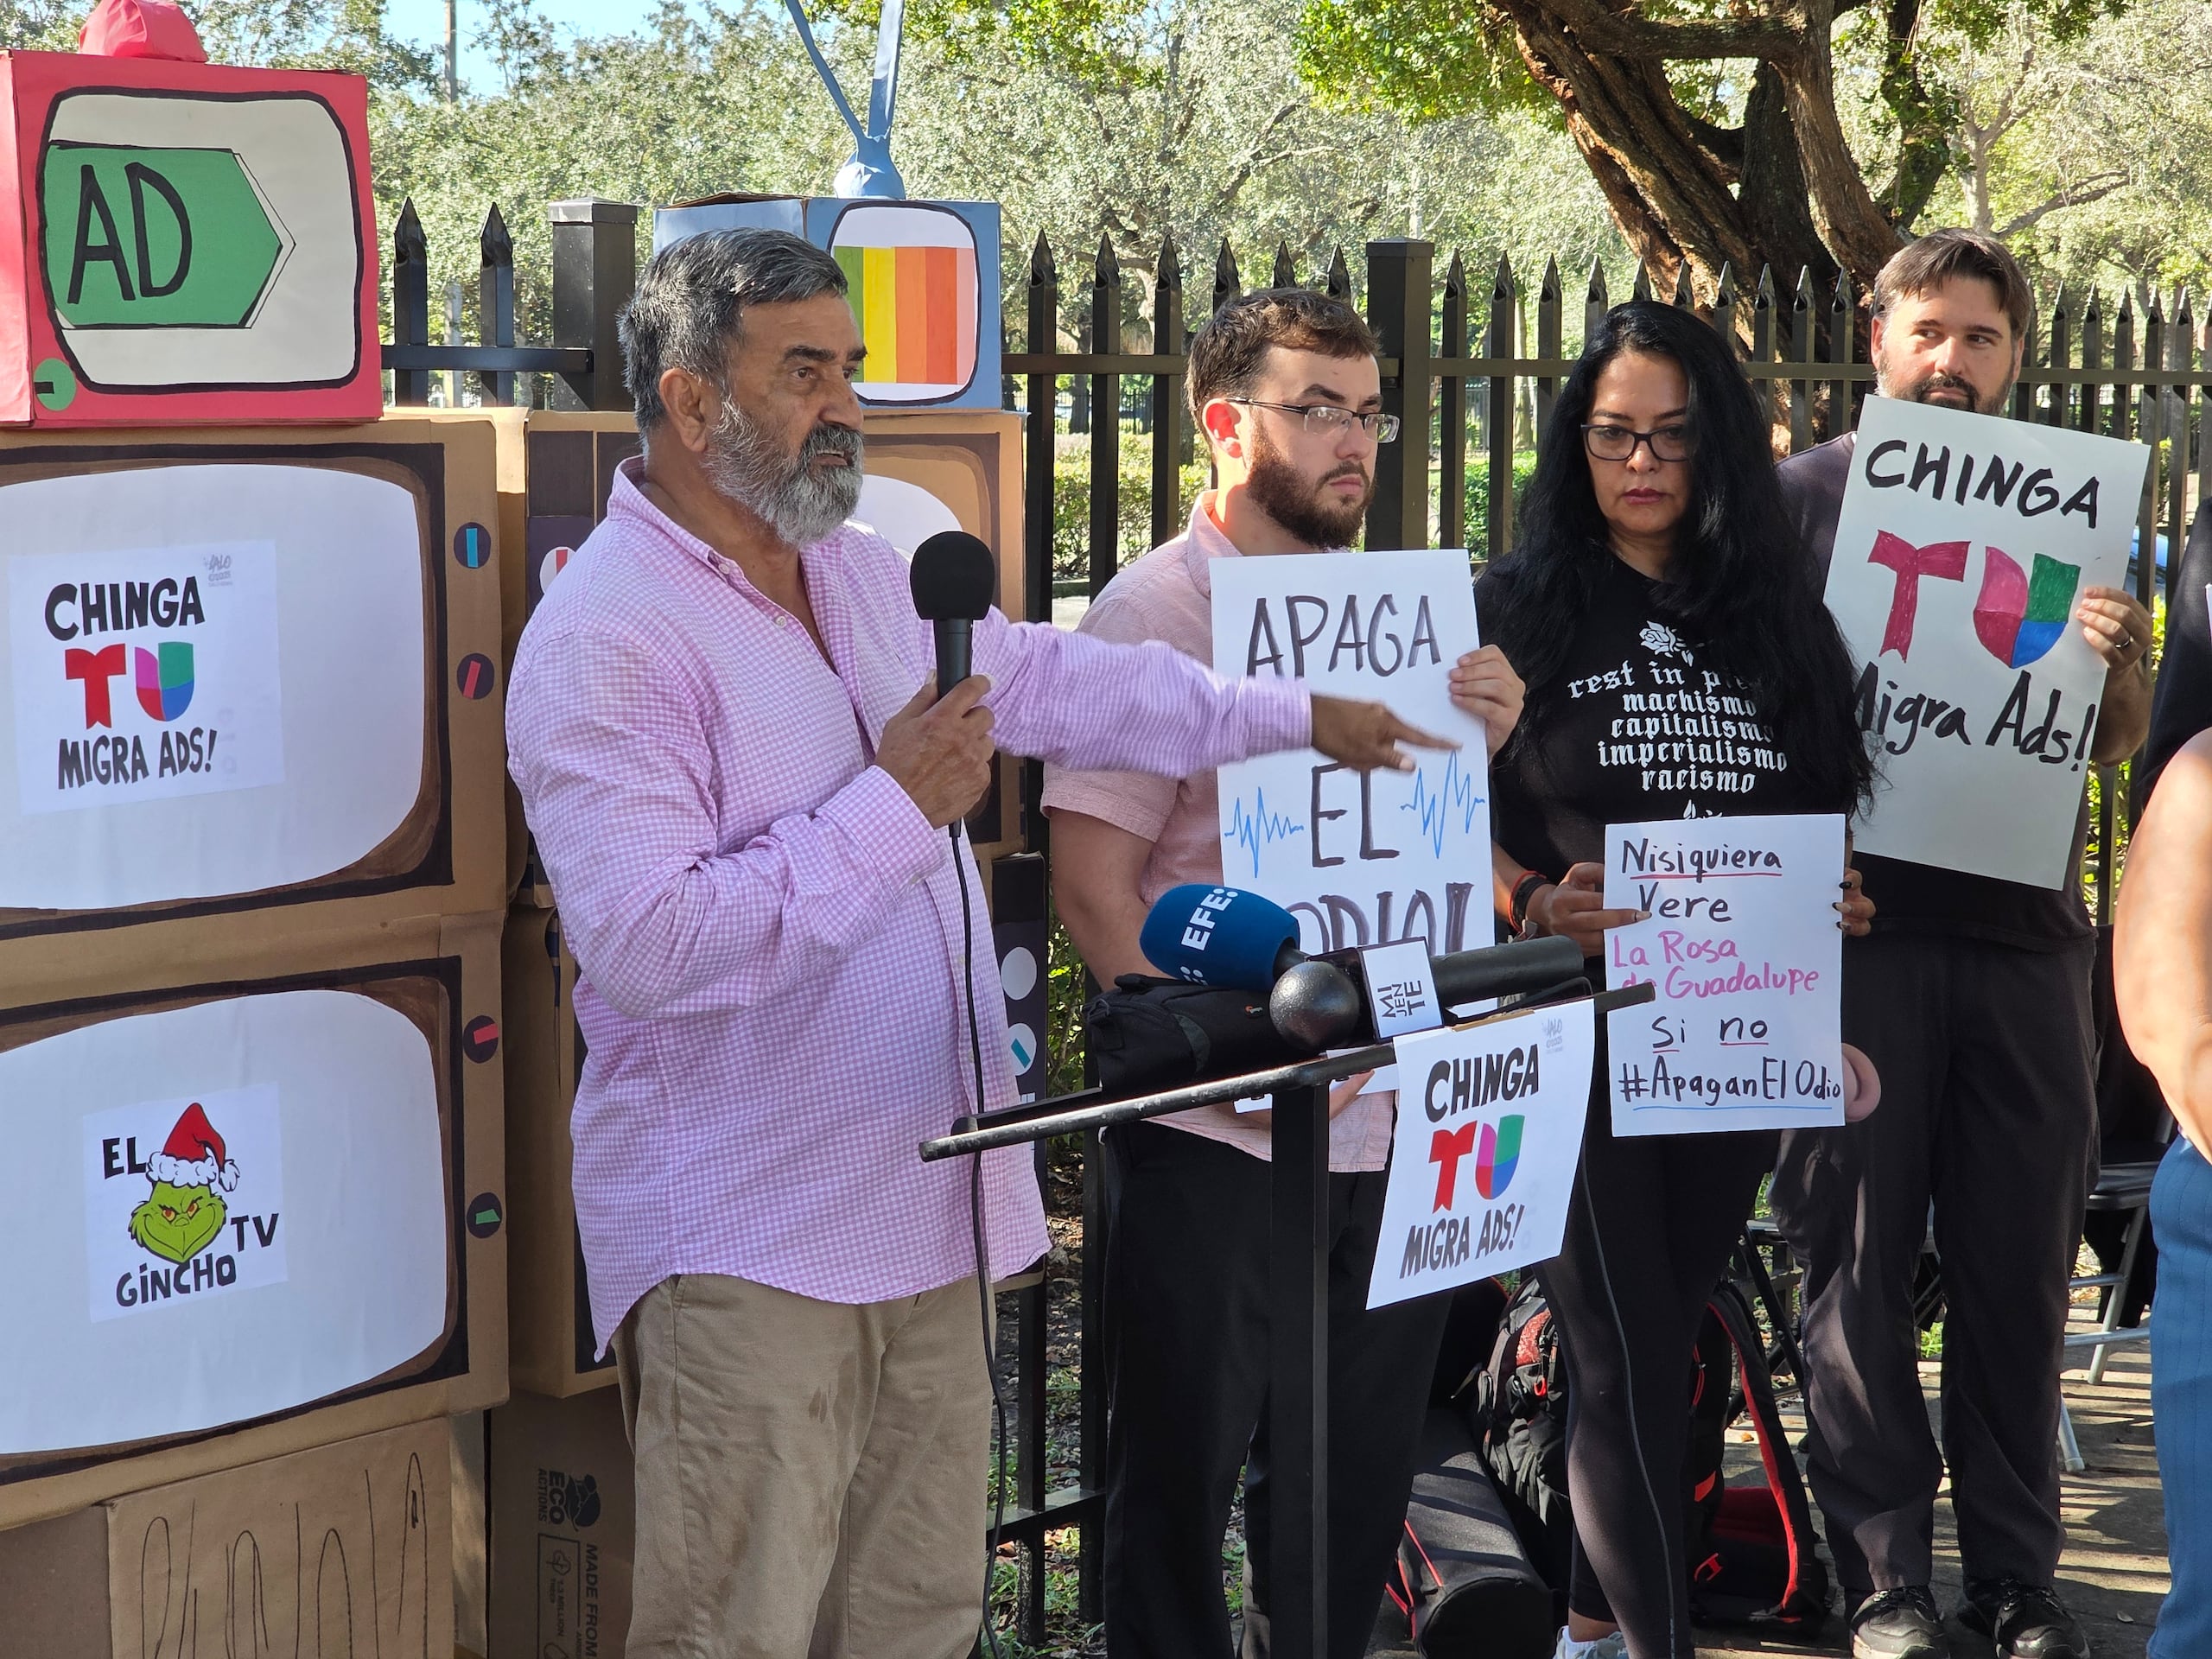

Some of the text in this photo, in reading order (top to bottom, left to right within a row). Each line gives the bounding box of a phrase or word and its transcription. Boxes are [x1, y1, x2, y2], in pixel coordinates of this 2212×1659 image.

[67, 162, 192, 305] AD
[1865, 439, 2100, 530] CHINGA
[44, 575, 206, 641] CHINGA
[1867, 529, 2082, 670] TU
[1246, 594, 1442, 679] APAGA
[64, 641, 195, 730] TU
[1567, 660, 1636, 698] rest
[1649, 660, 1685, 685] in
[1622, 690, 1757, 716] machismo
[1985, 669, 2097, 772] Ads!
[58, 726, 218, 790] MIGRA ADS!
[1598, 738, 1788, 772] imperialismo
[1641, 764, 1756, 793] racismo
[1310, 761, 1401, 868] EL
[1622, 837, 1783, 883] Nisiquiera
[1639, 881, 1732, 922] Vere
[1613, 930, 1739, 968] La Rosa
[1378, 986, 1396, 1019] MI
[1393, 983, 1406, 1017] JEN
[1404, 980, 1426, 1017] TE
[1664, 961, 1820, 998] Guadalupe
[1719, 1016, 1769, 1039] no
[1424, 1043, 1540, 1123] CHINGA
[102, 1136, 147, 1180] EL
[1428, 1114, 1525, 1214] TU
[230, 1212, 279, 1253] TV
[1399, 1202, 1526, 1280] MIGRA ADS!
[537, 1468, 547, 1522] ACTIONS
[549, 1471, 565, 1525] ECO
[586, 1544, 598, 1657] MADE FROM
